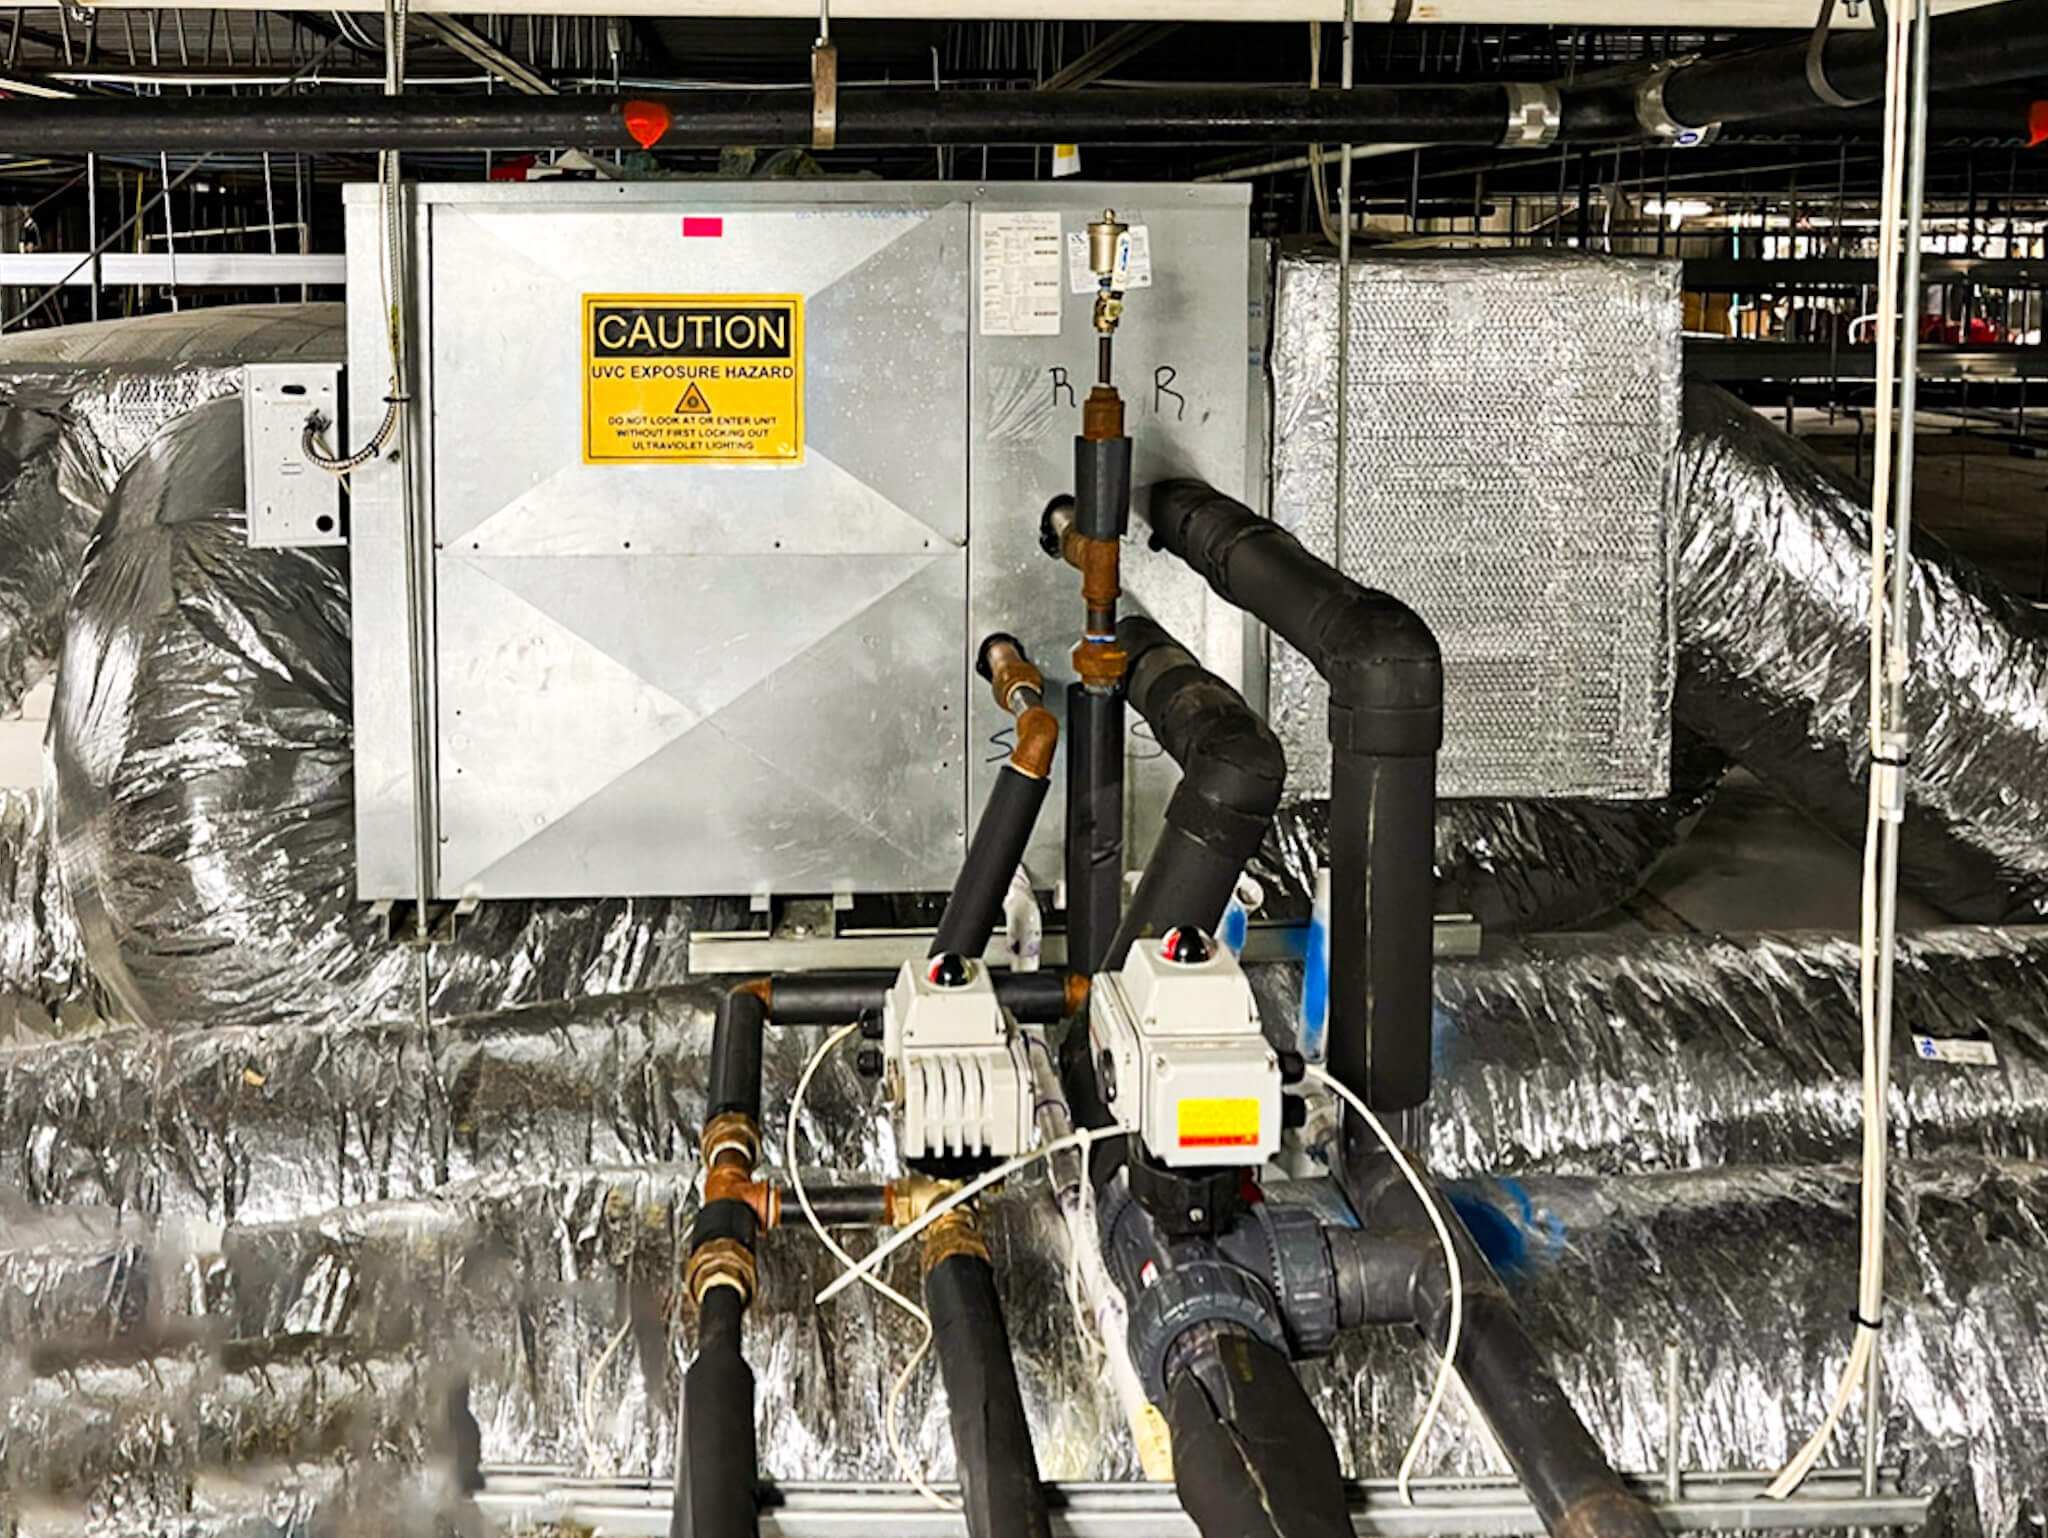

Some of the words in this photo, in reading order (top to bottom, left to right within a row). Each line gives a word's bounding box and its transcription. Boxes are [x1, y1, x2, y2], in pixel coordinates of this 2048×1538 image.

[597, 314, 786, 350] CAUTION
[591, 366, 625, 378] UVC
[631, 366, 720, 378] EXPOSURE
[726, 366, 794, 378] HAZARD
[1048, 366, 1077, 408] R
[1154, 365, 1185, 421] R
[607, 416, 624, 425] DO
[627, 416, 647, 425] NOT
[650, 416, 679, 425] LOOK
[683, 416, 695, 425] AT
[698, 416, 713, 425] OR
[717, 416, 750, 425] ENTER
[754, 416, 776, 425] UNIT
[616, 429, 663, 437] WITHOUT
[667, 429, 695, 437] FIRST
[698, 429, 745, 437] LOCKING
[748, 429, 769, 437] OUT
[632, 441, 702, 450] ULTRAVIOLET
[705, 441, 754, 450] LIGHTING
